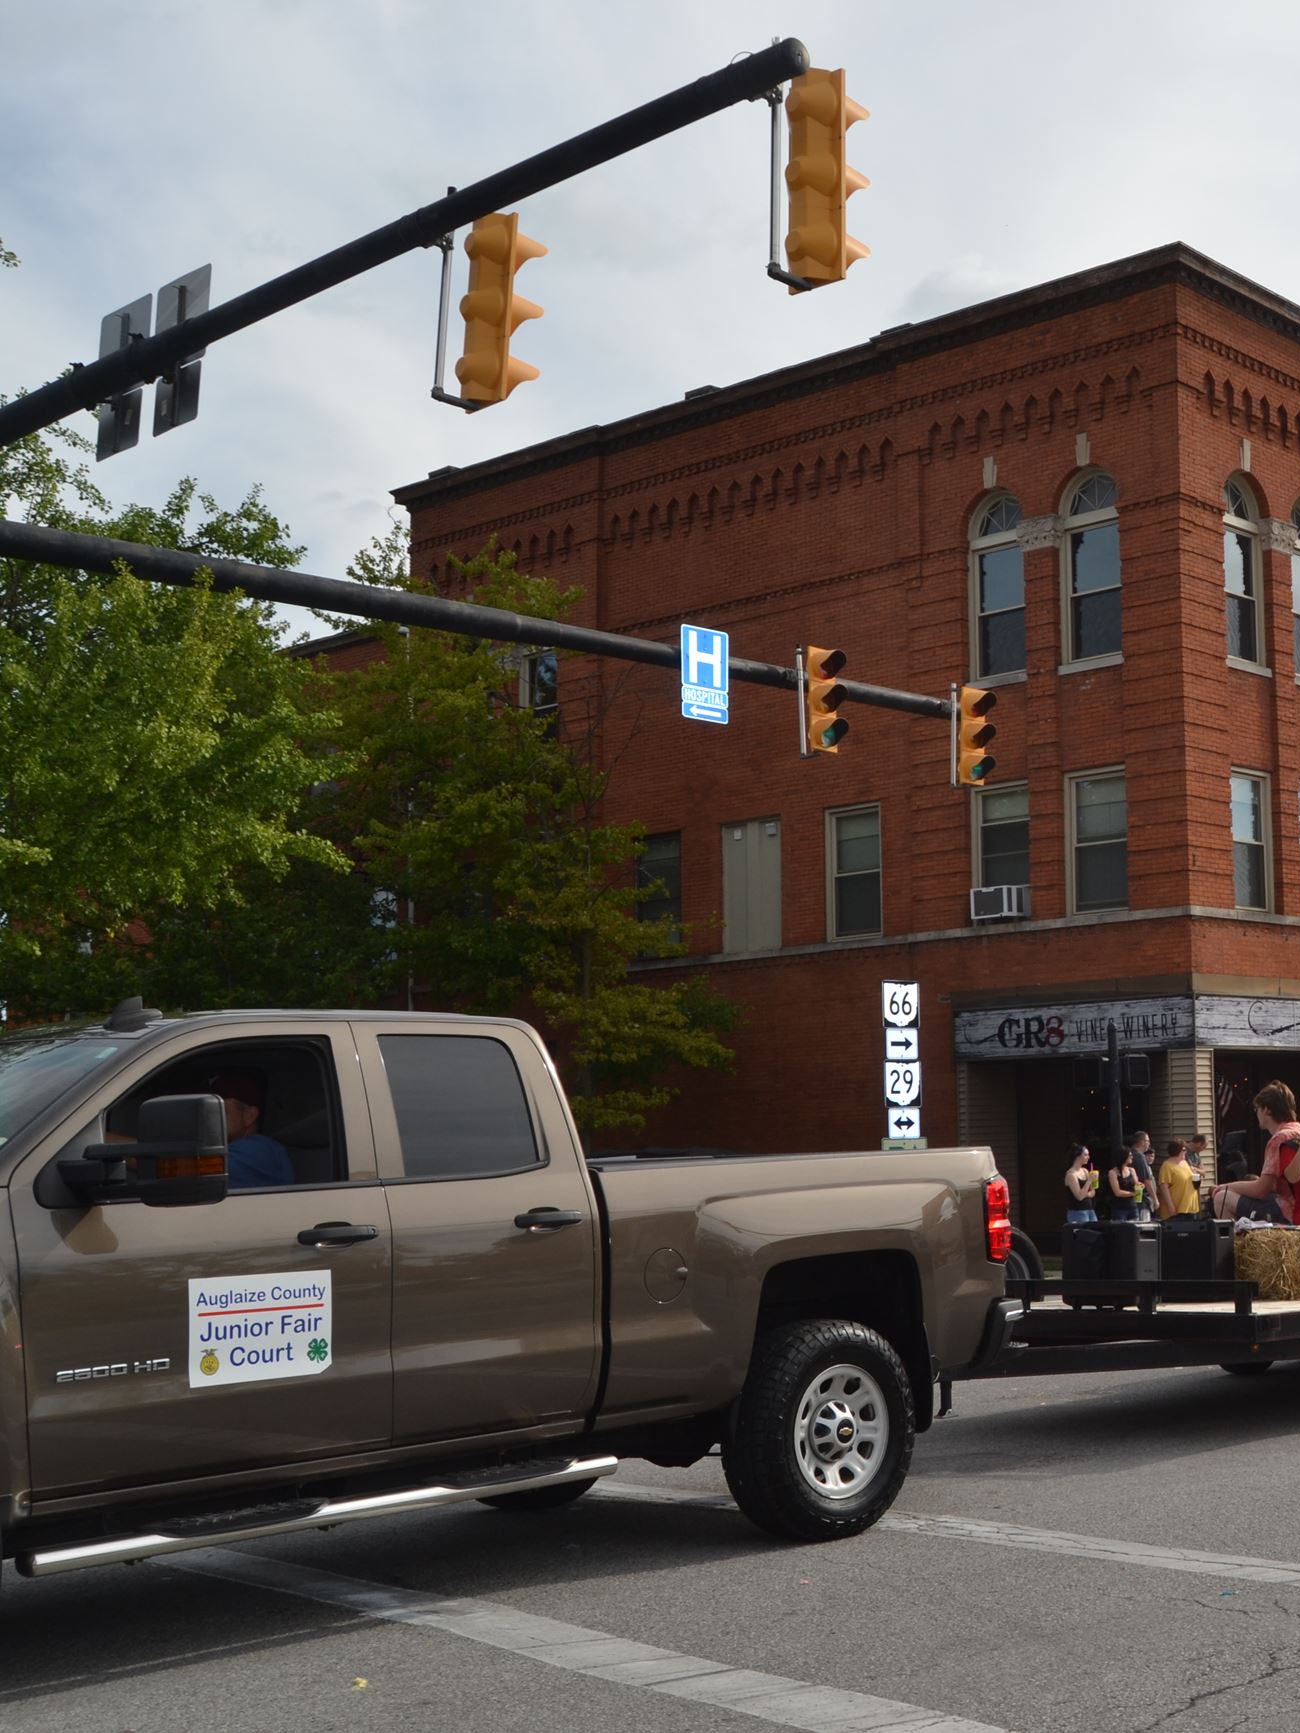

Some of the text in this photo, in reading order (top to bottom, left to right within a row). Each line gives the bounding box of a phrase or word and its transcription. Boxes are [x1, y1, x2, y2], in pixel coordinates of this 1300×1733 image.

[688, 629, 722, 688] H
[684, 687, 726, 707] HOSPITAL
[889, 991, 912, 1016] 66
[998, 1015, 1065, 1049] GR8
[1122, 1012, 1179, 1040] WINERY
[890, 1069, 914, 1095] 29
[196, 1283, 327, 1309] Auglaize County
[199, 1312, 323, 1343] Junior Fair
[228, 1341, 295, 1367] Court
[56, 1357, 171, 1383] 2500 HD
